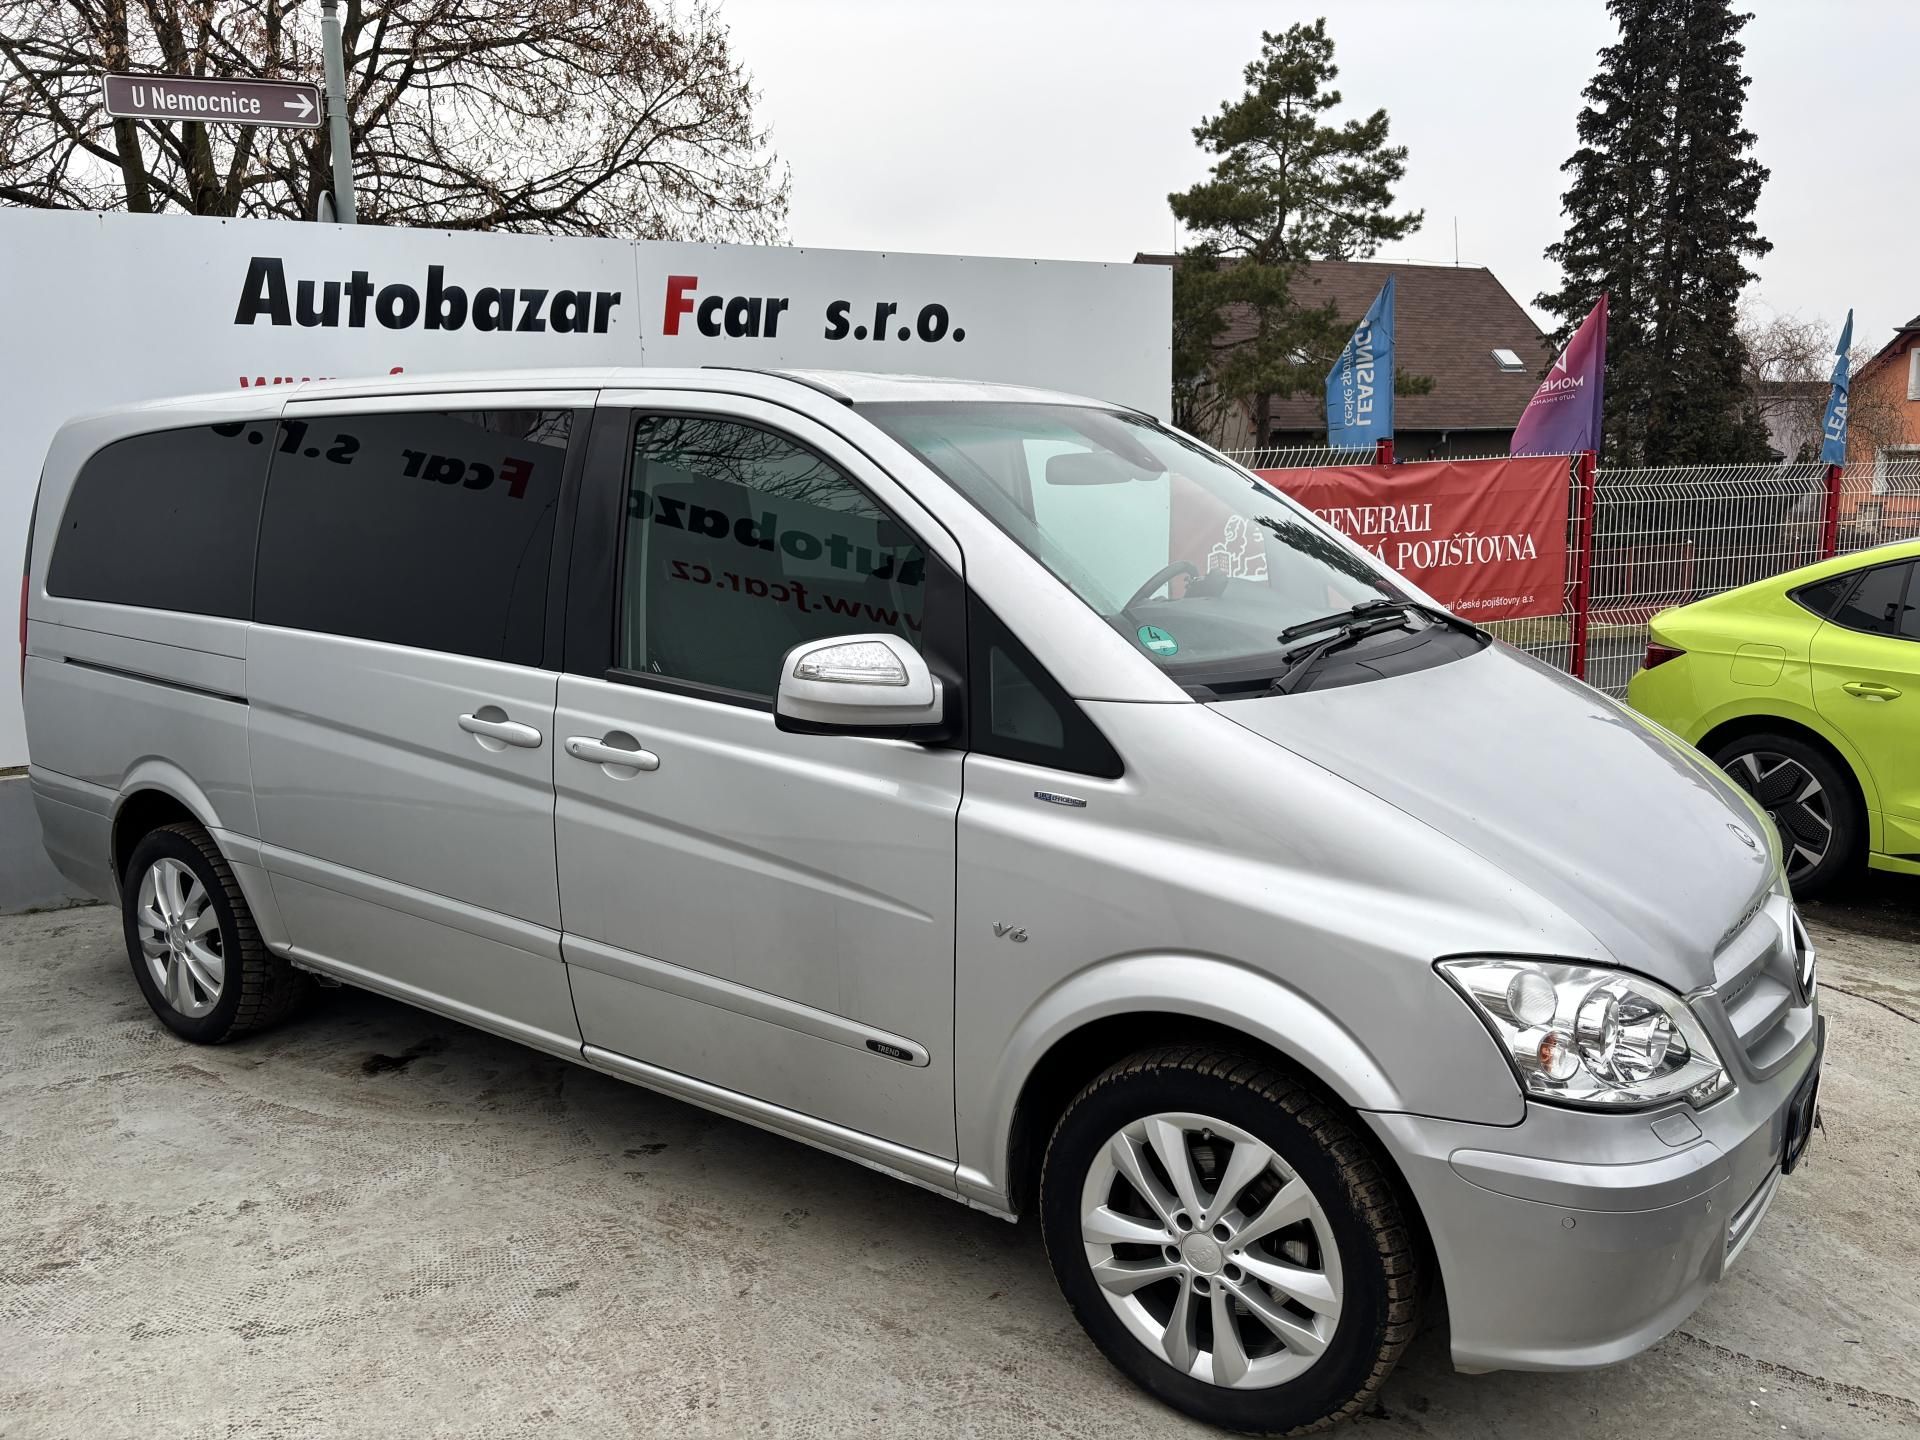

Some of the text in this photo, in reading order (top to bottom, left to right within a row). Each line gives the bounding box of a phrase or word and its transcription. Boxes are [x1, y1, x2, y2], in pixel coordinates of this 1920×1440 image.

[132, 86, 261, 114] U Nemocnice
[234, 256, 966, 343] Autobazar Fcar s.r.o.
[1396, 531, 1538, 570] POJIŠŤOVNA
[1456, 599, 1480, 610] České
[1147, 626, 1161, 641] 4
[992, 921, 1028, 943] V6
[877, 1044, 900, 1057] TREND
